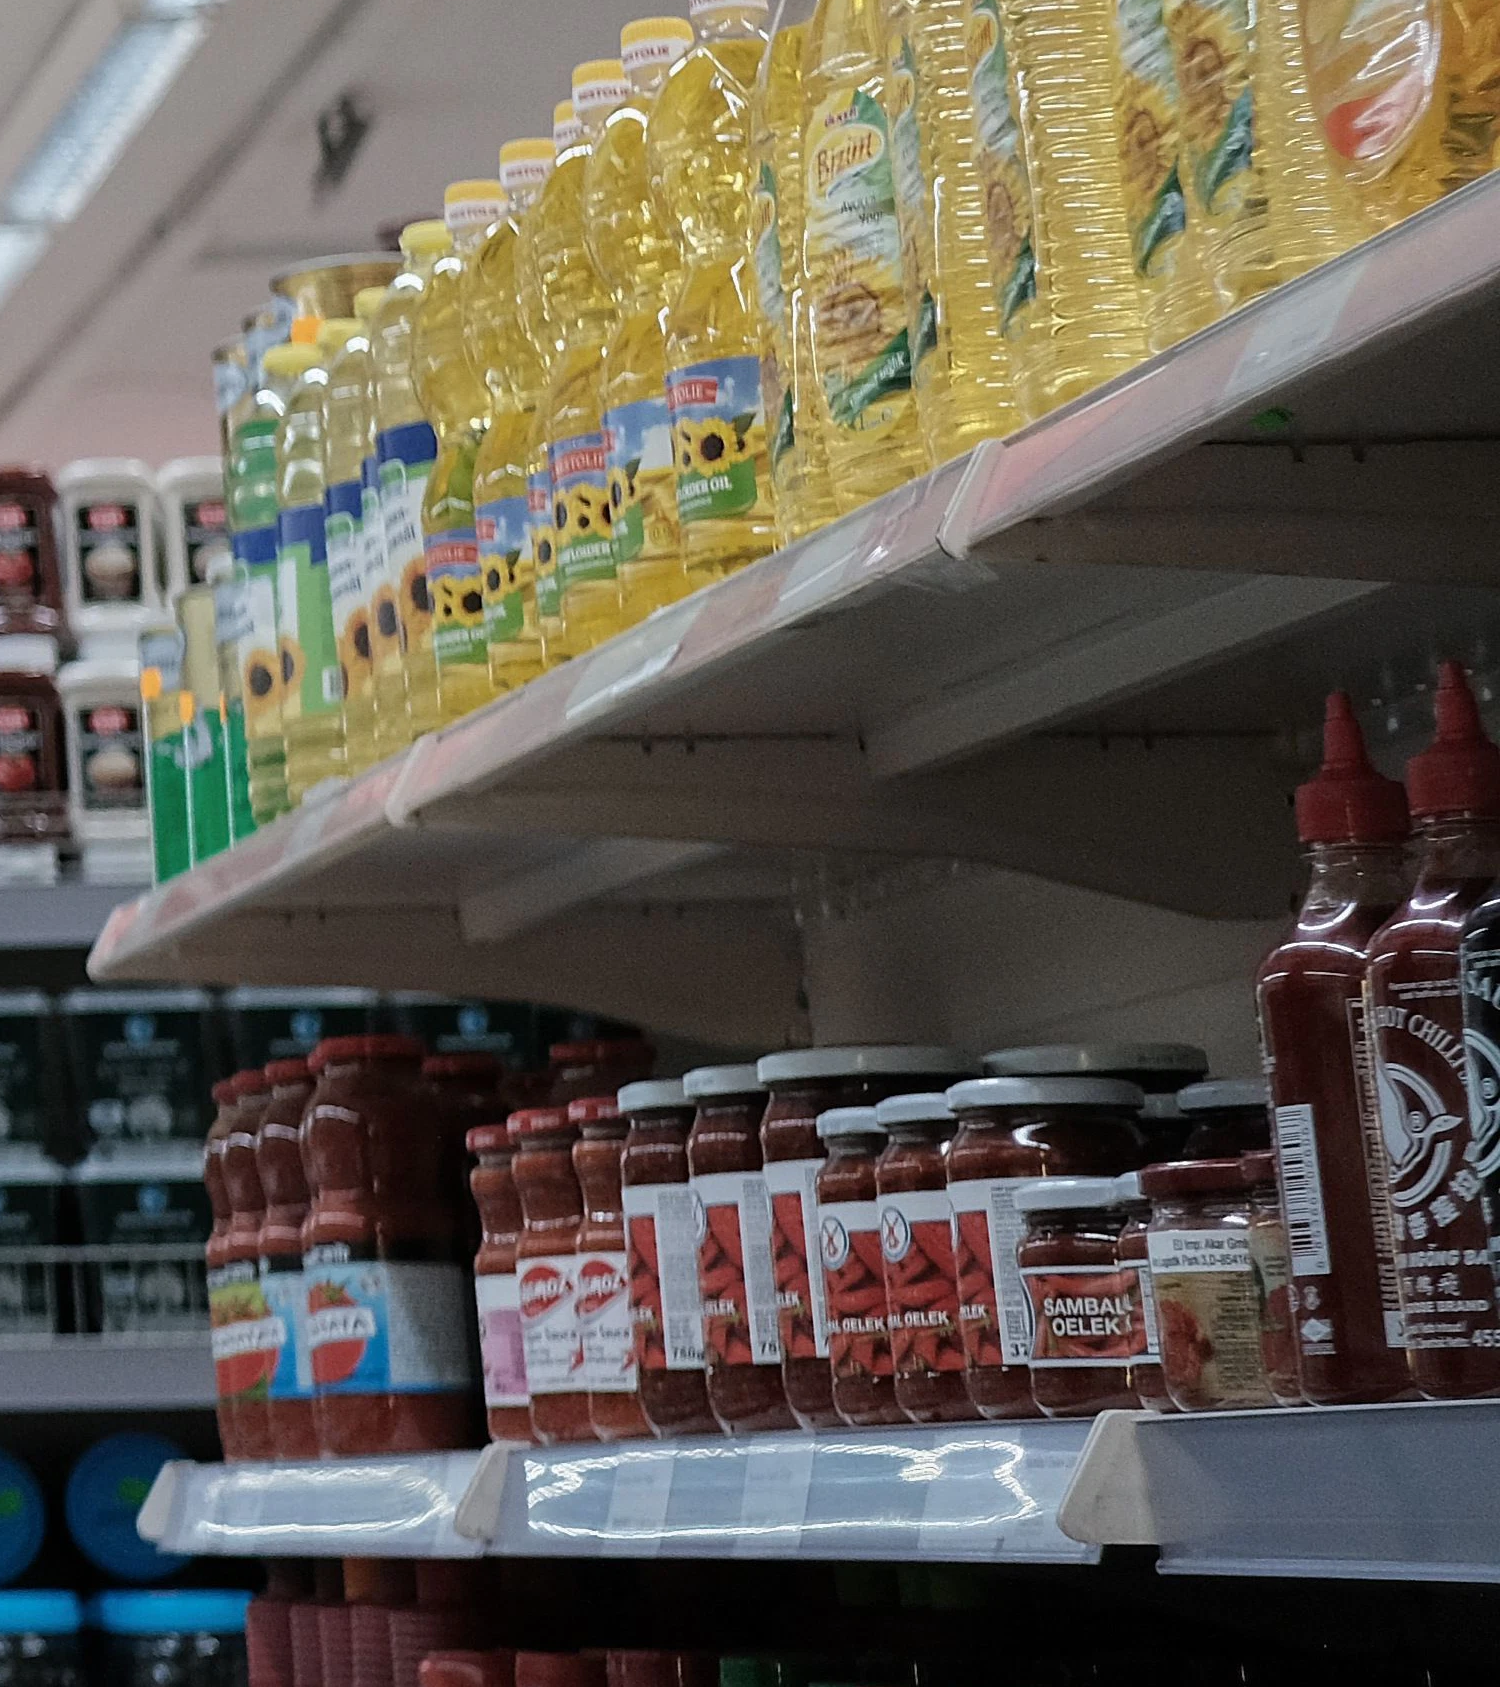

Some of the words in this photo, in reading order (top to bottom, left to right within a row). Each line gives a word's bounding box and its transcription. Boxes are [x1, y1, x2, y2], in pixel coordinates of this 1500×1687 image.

[816, 131, 874, 187] Bizim
[1043, 1296, 1125, 1317] SAMBAL
[903, 1310, 950, 1329] OELEK
[1052, 1316, 1119, 1337] OELEK
